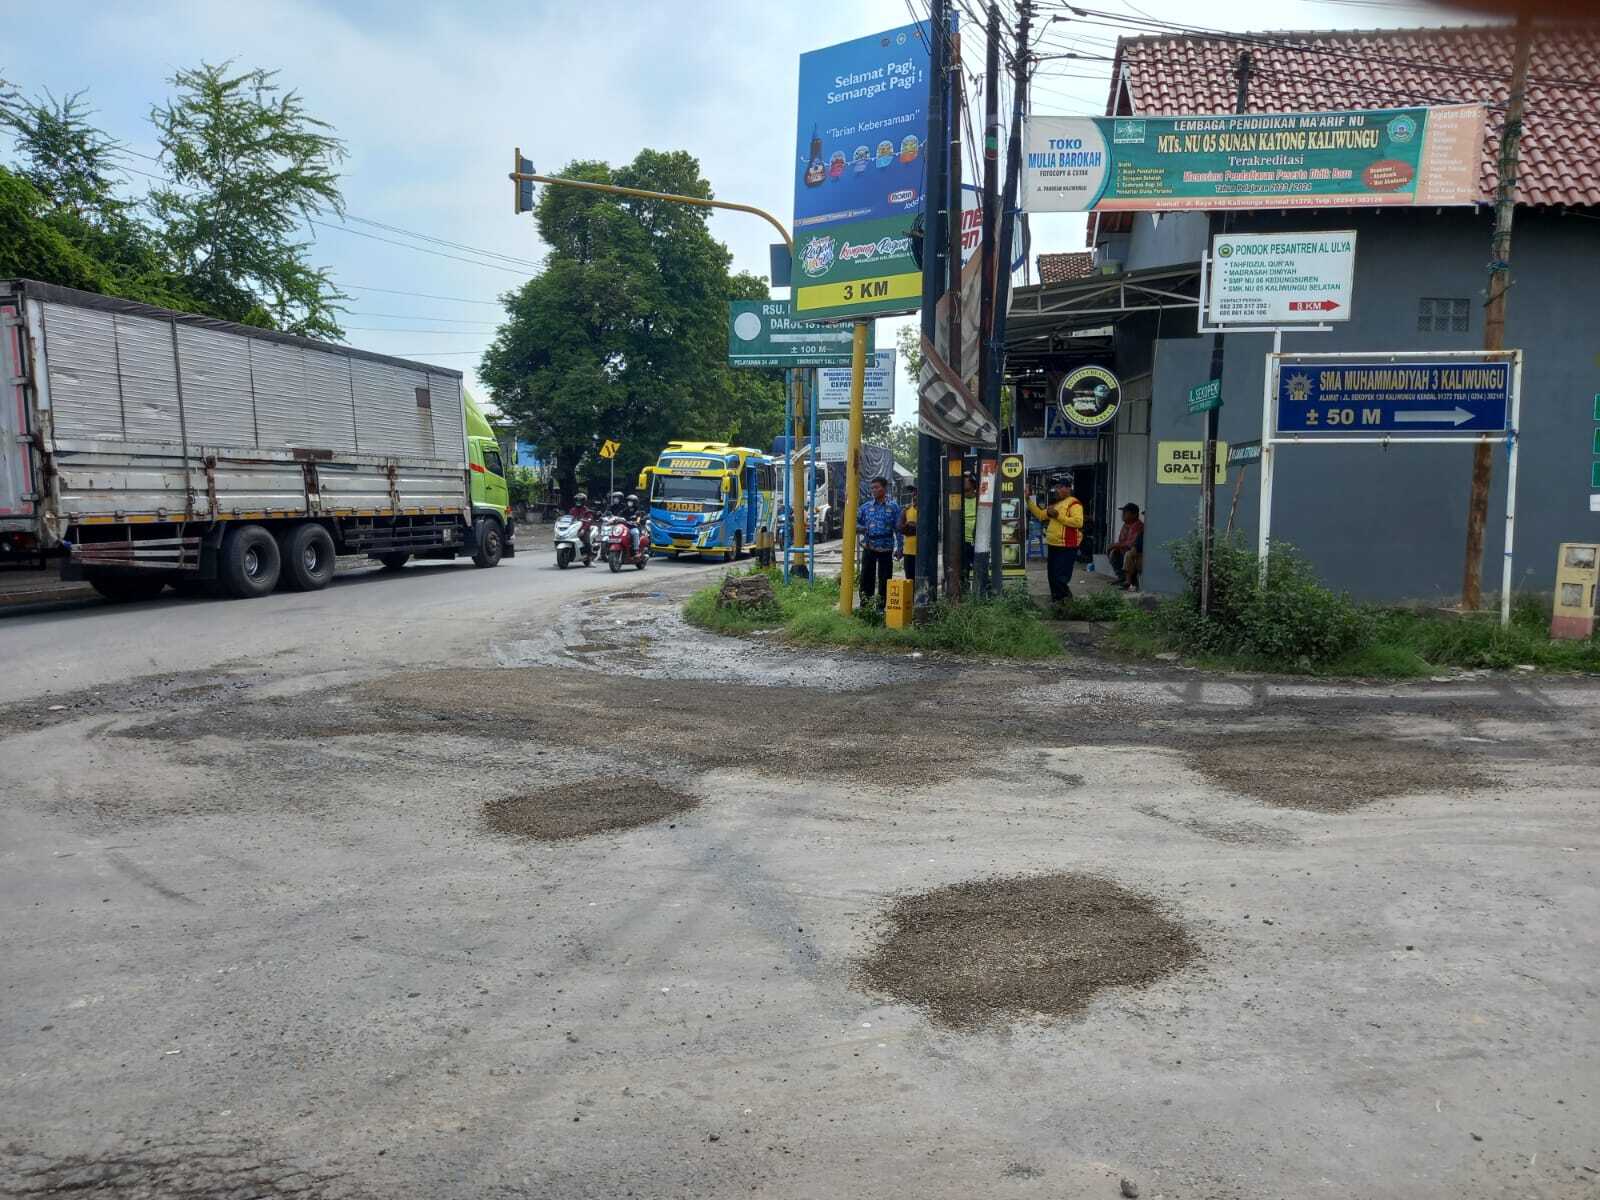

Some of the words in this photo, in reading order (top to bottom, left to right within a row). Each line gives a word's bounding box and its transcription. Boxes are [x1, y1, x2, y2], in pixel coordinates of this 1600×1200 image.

[835, 67, 884, 88] Selamat
[887, 57, 916, 75] Pagi,
[826, 81, 886, 104] Semangat
[889, 74, 915, 89] Pagi
[1174, 120, 1225, 131] LEMBAGA
[1229, 117, 1296, 130] PENDIDIKAN
[1299, 115, 1345, 128] MA'ARIF
[1349, 115, 1365, 127] NU
[1048, 139, 1082, 150] TOKO
[1157, 135, 1182, 153] MTs.
[1184, 134, 1201, 152] NU
[1202, 134, 1216, 152] 05
[1218, 133, 1257, 152] SUNAN
[1259, 131, 1306, 151] KATONG
[1307, 129, 1379, 149] KALIWUNGU
[1028, 152, 1056, 168] MULIA
[1059, 151, 1102, 167] BAROKAH
[1228, 154, 1304, 166] Terakreditasi
[1235, 244, 1268, 255] PONDOK
[1270, 243, 1317, 254] PESANTREN
[1318, 242, 1329, 253] AL
[1331, 241, 1351, 252] ULYA
[843, 285, 854, 301] 3
[860, 280, 889, 299] KM
[762, 304, 785, 315] RSU.
[1305, 302, 1322, 310] KM
[800, 345, 816, 353] 100
[819, 345, 826, 353] M
[1320, 371, 1342, 391] SMA
[1344, 370, 1429, 390] MUHAMMADIYAH
[1432, 369, 1438, 390] 3
[1441, 369, 1504, 390] KALIWUNGU
[1306, 408, 1319, 425] ±
[1326, 408, 1354, 425] 50
[1361, 408, 1381, 425] M
[1172, 450, 1201, 460] BELI
